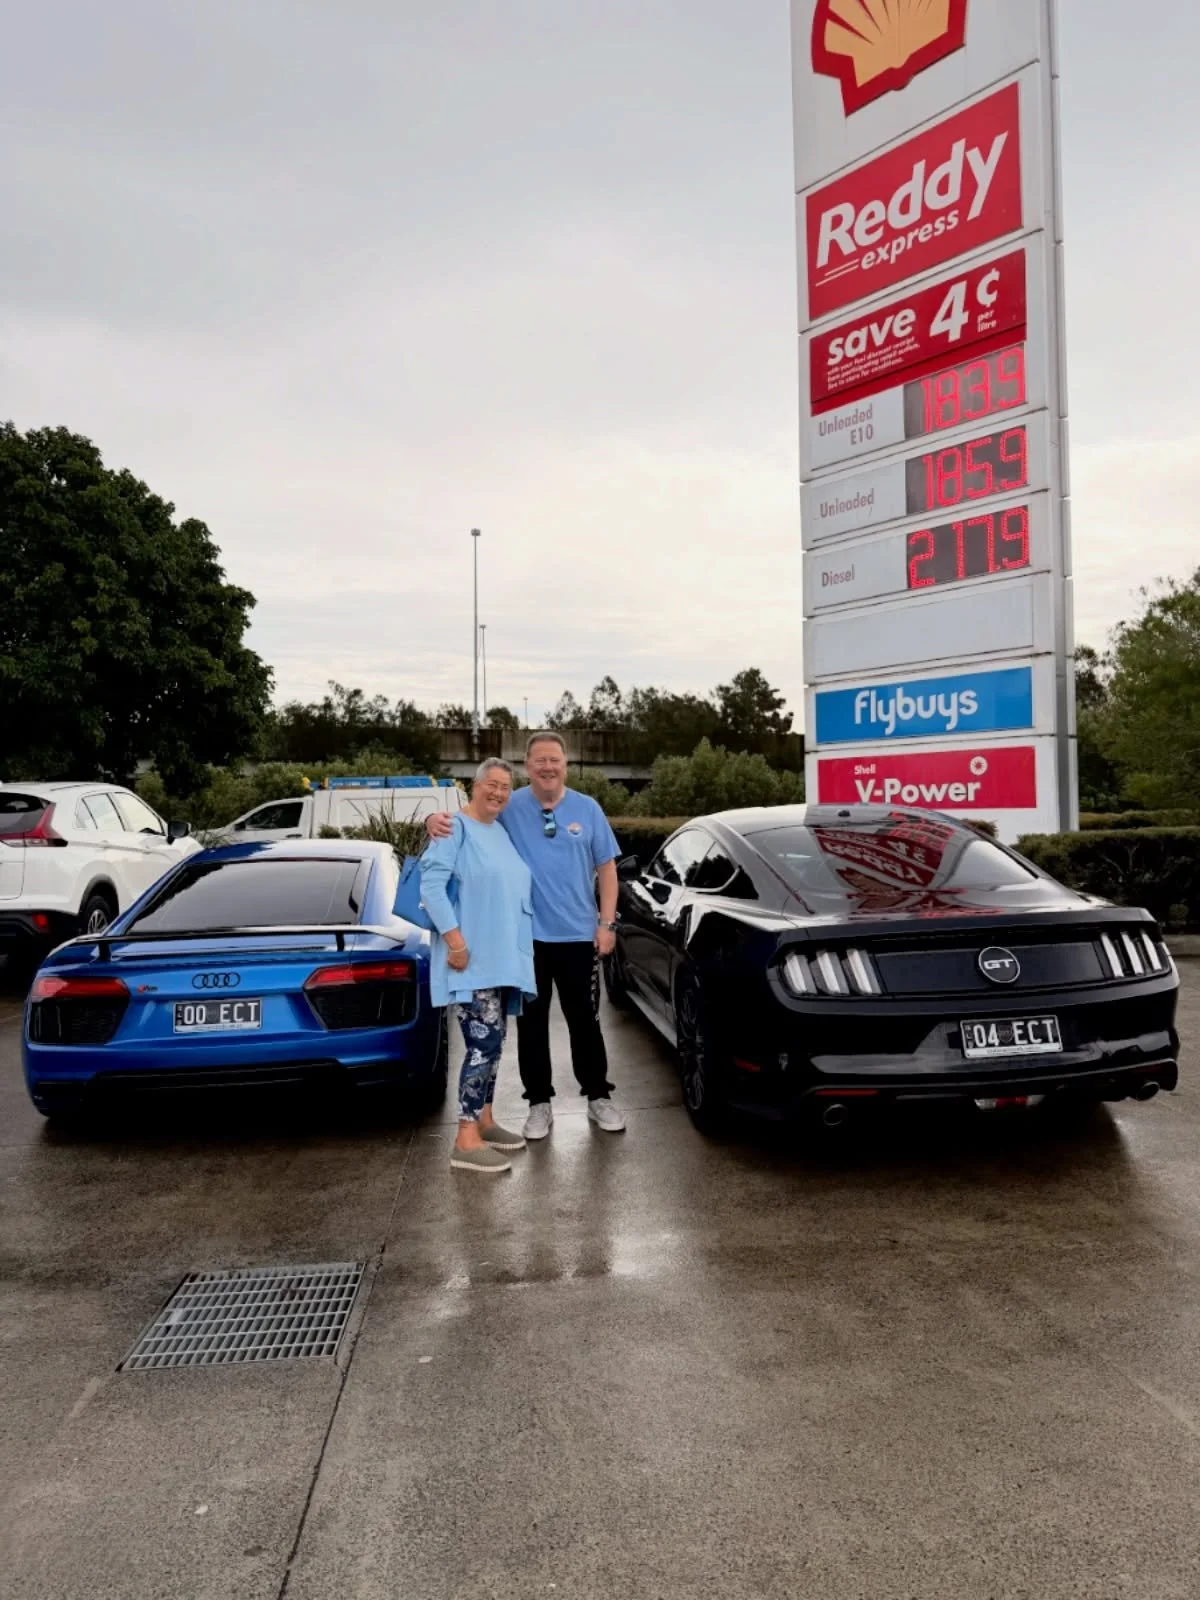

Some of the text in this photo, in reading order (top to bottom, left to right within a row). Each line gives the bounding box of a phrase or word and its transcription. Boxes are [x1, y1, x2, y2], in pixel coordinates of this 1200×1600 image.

[815, 131, 1008, 268] Reddy
[861, 210, 959, 271] express
[827, 308, 916, 366] save
[818, 403, 873, 436] Unleaded
[850, 424, 873, 445] E10
[820, 488, 874, 518] Unleaded
[822, 564, 855, 588] Diesel
[854, 687, 979, 736] flybuys
[854, 763, 877, 775] Shell
[854, 778, 981, 804] V-Power
[983, 958, 1014, 970] GT
[220, 1002, 259, 1022] ECT
[973, 1023, 1000, 1048] 04
[1012, 1019, 1054, 1045] ECT
